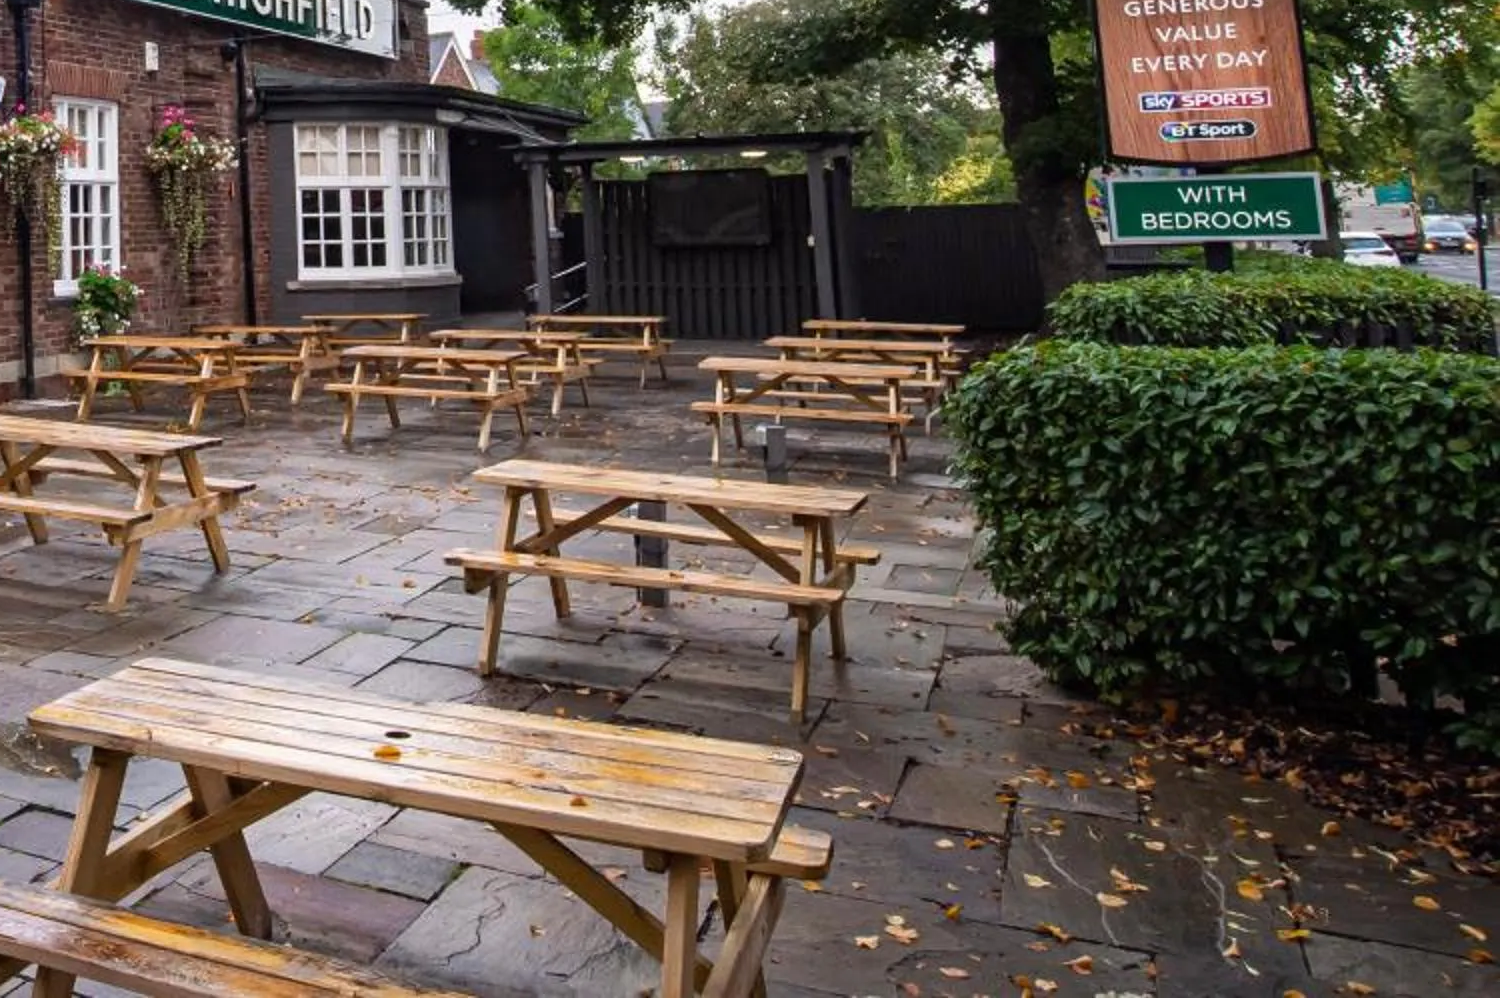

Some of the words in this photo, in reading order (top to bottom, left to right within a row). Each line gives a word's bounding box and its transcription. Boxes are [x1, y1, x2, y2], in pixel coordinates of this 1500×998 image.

[1156, 22, 1238, 44] VALUE
[1131, 53, 1209, 74] EVERY
[1216, 49, 1268, 70] DAY
[1145, 94, 1176, 111] sky
[1181, 91, 1265, 108] SPORTS
[1171, 124, 1197, 138] BT
[1199, 122, 1245, 139] Sport
[1176, 185, 1247, 204] WITH
[1140, 210, 1292, 231] BEDROOMS
